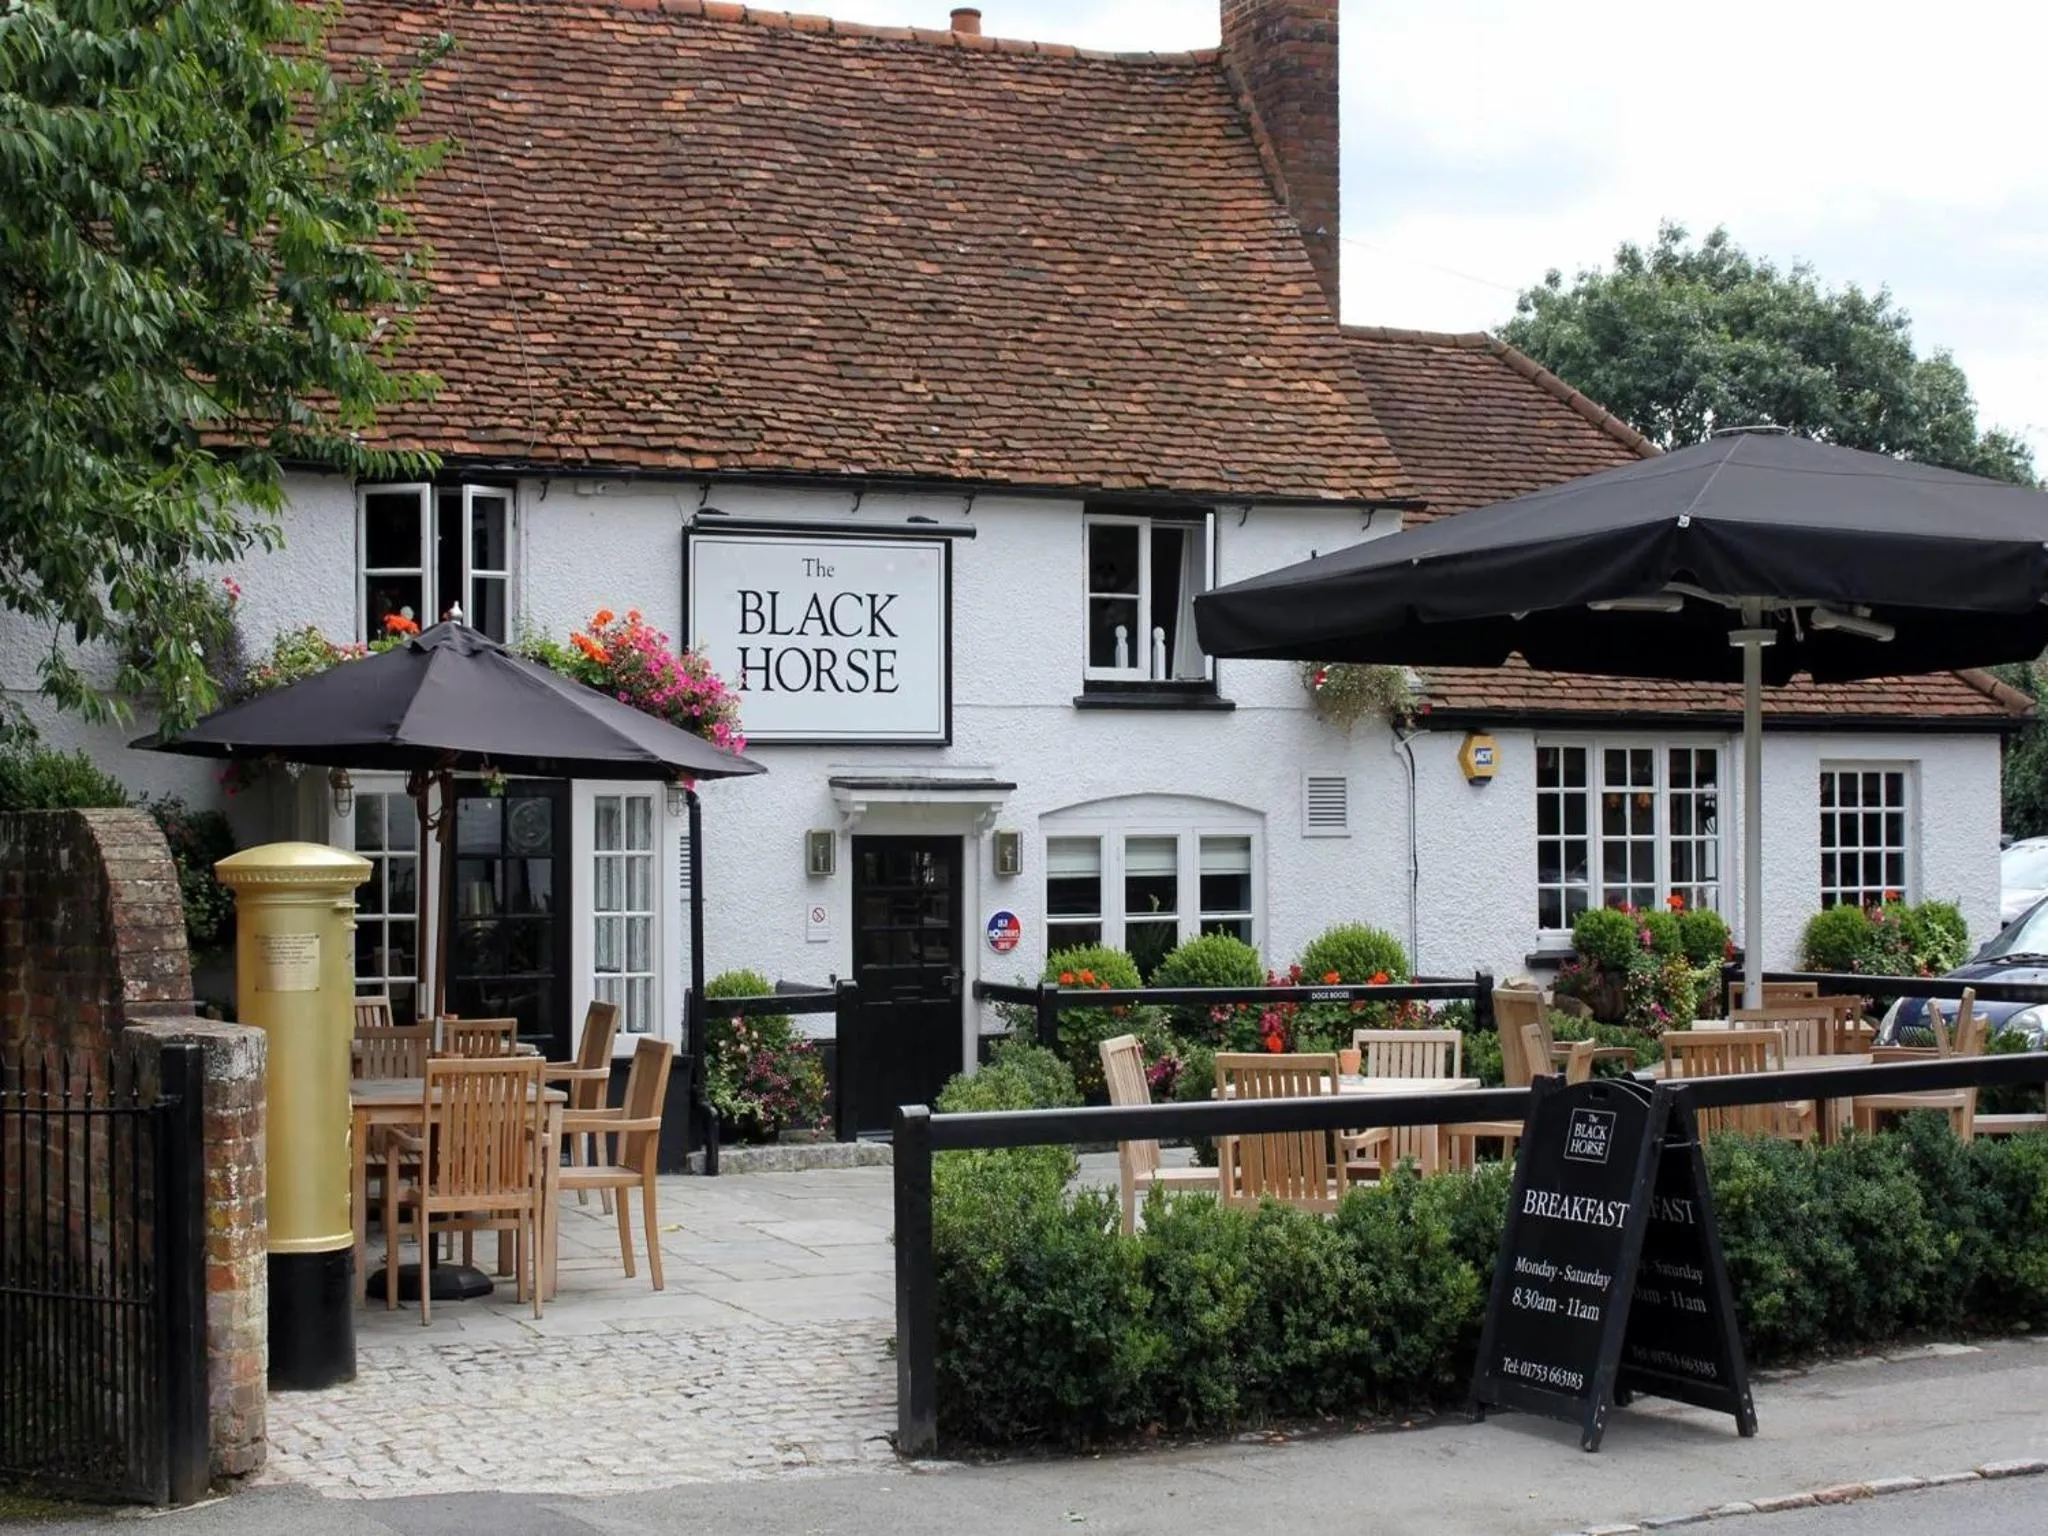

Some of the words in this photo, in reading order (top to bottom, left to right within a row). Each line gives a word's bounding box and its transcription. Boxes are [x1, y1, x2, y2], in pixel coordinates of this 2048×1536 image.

[802, 557, 835, 578] The
[737, 589, 899, 638] BLACK
[737, 646, 899, 693] HORSE
[1570, 1138, 1606, 1156] HORSE
[1574, 1122, 1608, 1140] BLACK
[1522, 1189, 1631, 1228] BREAKFAST
[1515, 1256, 1558, 1282] Monday
[1563, 1264, 1612, 1292] Saturday
[1512, 1286, 1557, 1312] 8.30am
[1567, 1297, 1600, 1321] 11am
[1520, 1361, 1548, 1382] 01753
[1548, 1366, 1584, 1390] 663183
